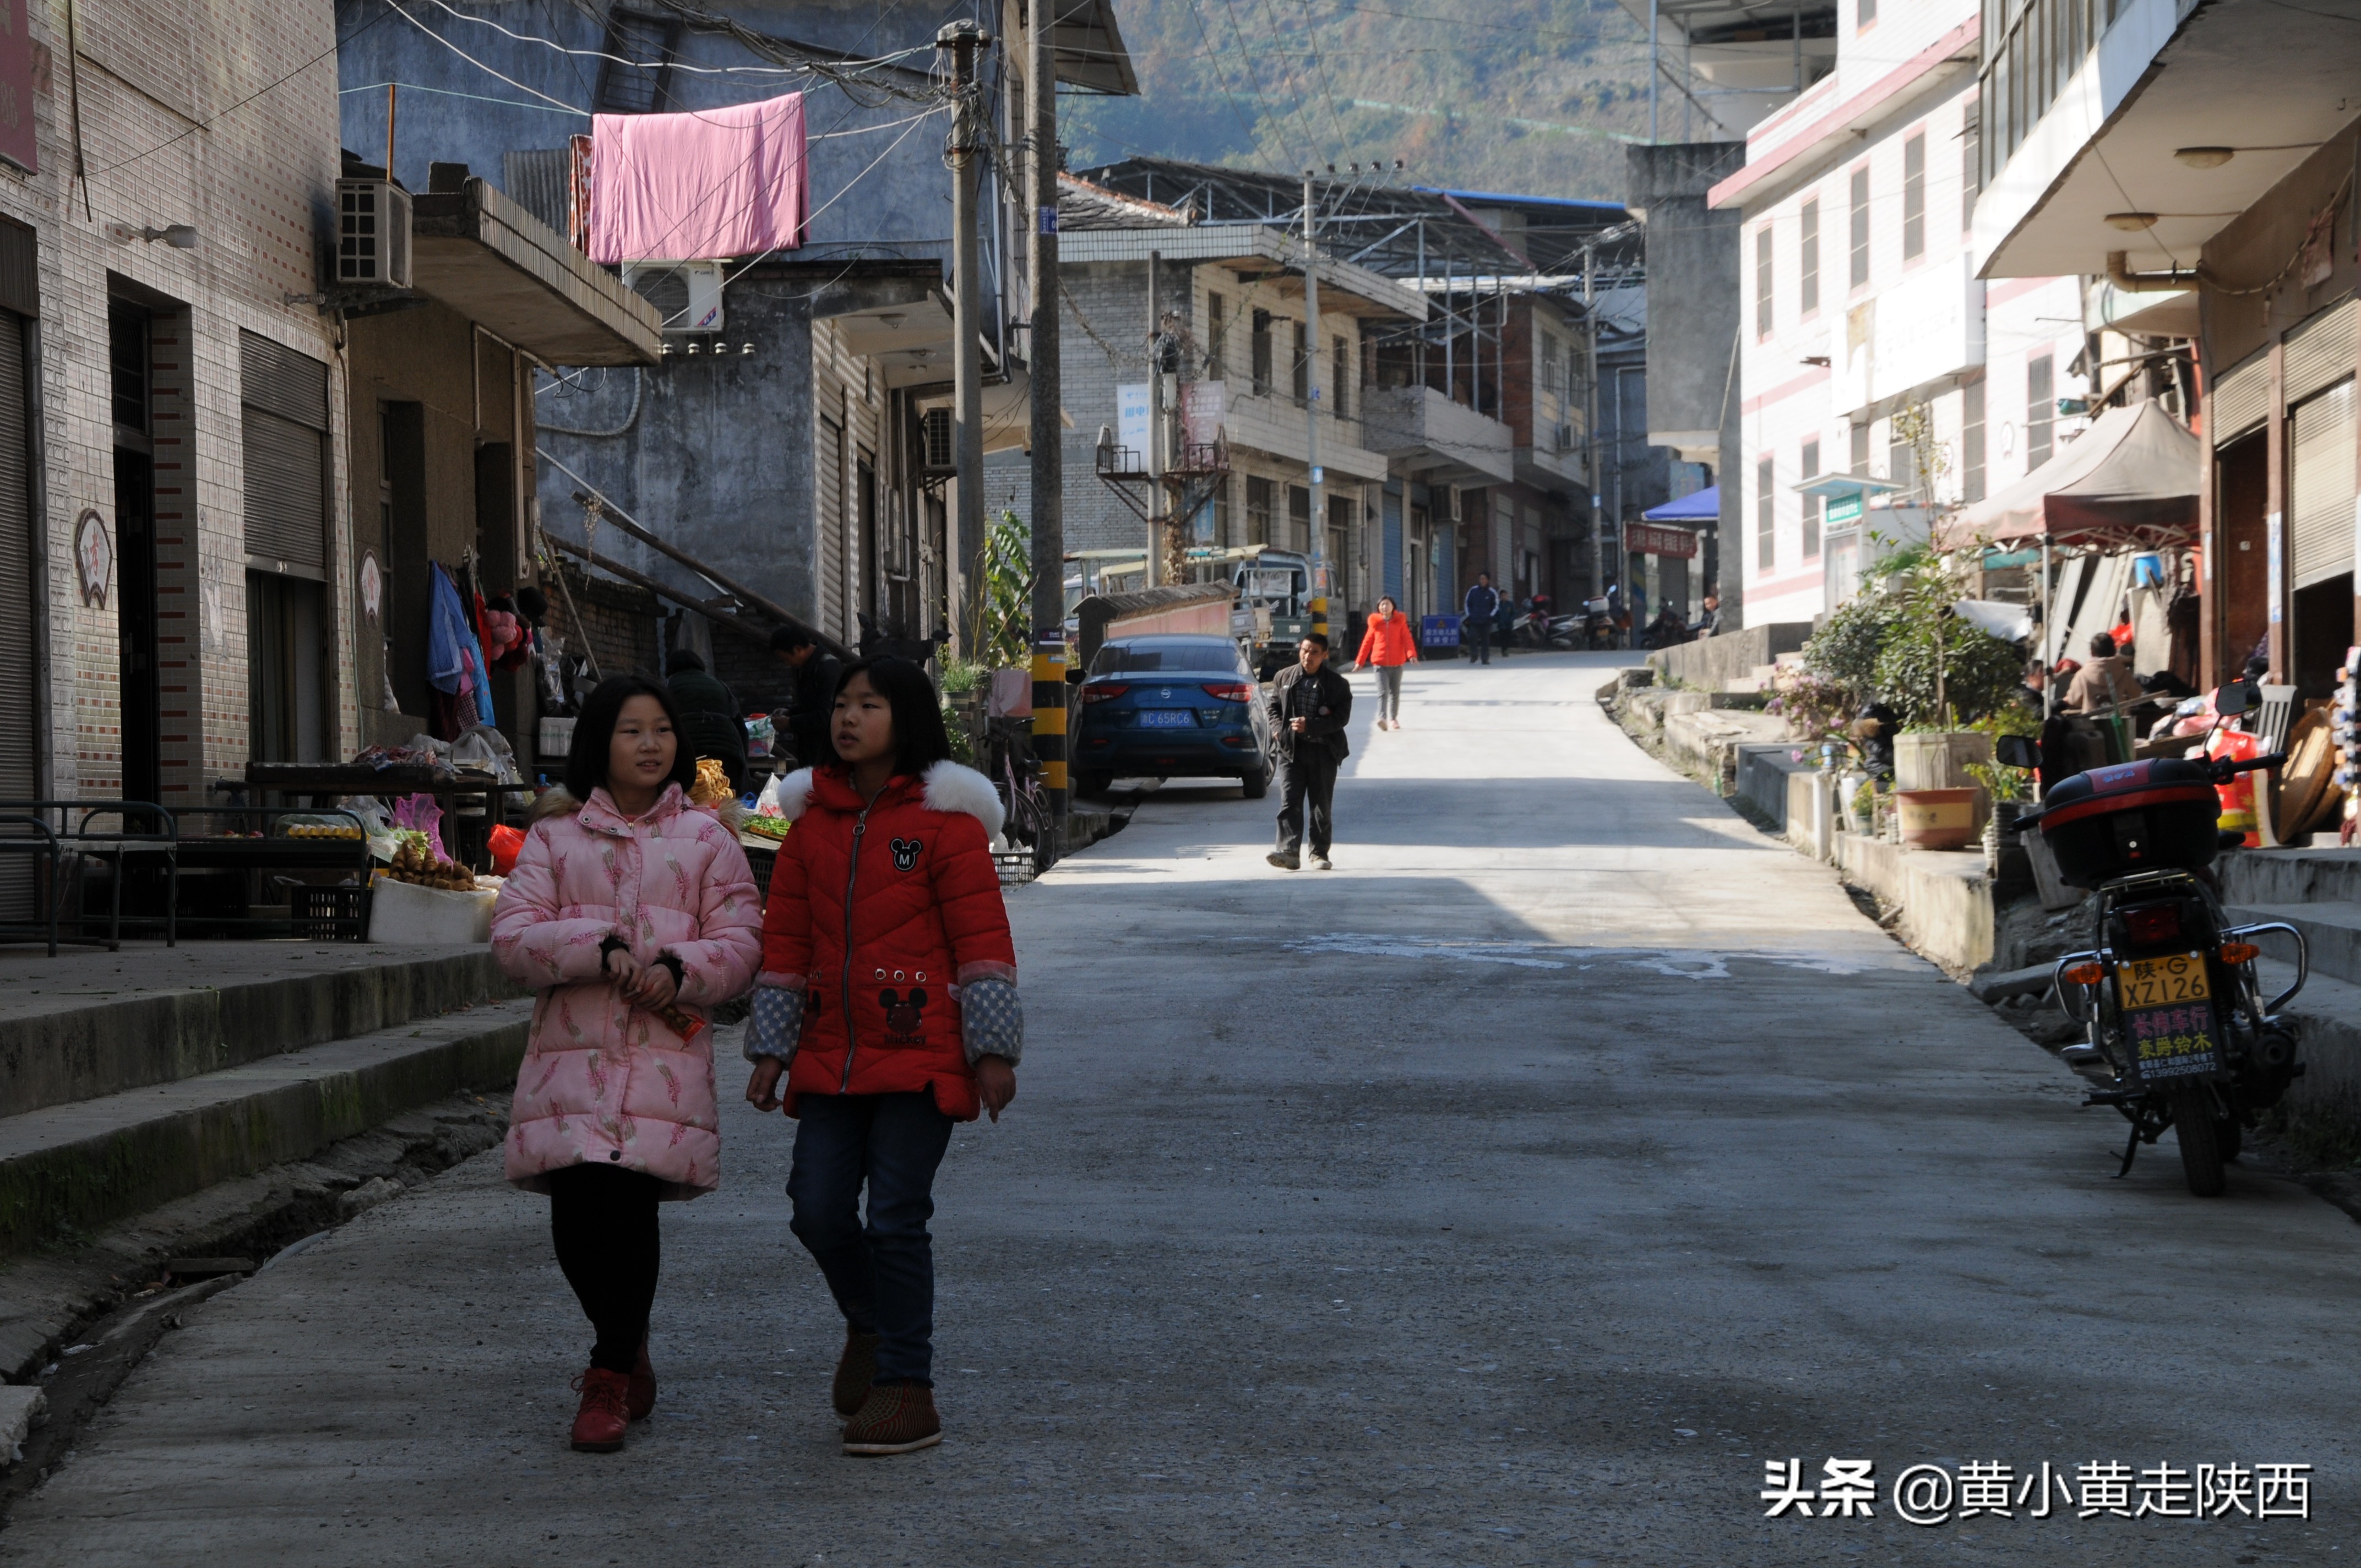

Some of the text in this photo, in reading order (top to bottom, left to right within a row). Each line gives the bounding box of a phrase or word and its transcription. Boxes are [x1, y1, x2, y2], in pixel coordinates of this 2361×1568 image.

[899, 853, 910, 865] M
[2125, 975, 2204, 1006] XZ126
[2132, 1006, 2208, 1039] 长伟车行
[884, 1034, 927, 1045] Mickey
[2137, 1031, 2212, 1059] 豪爵铃木
